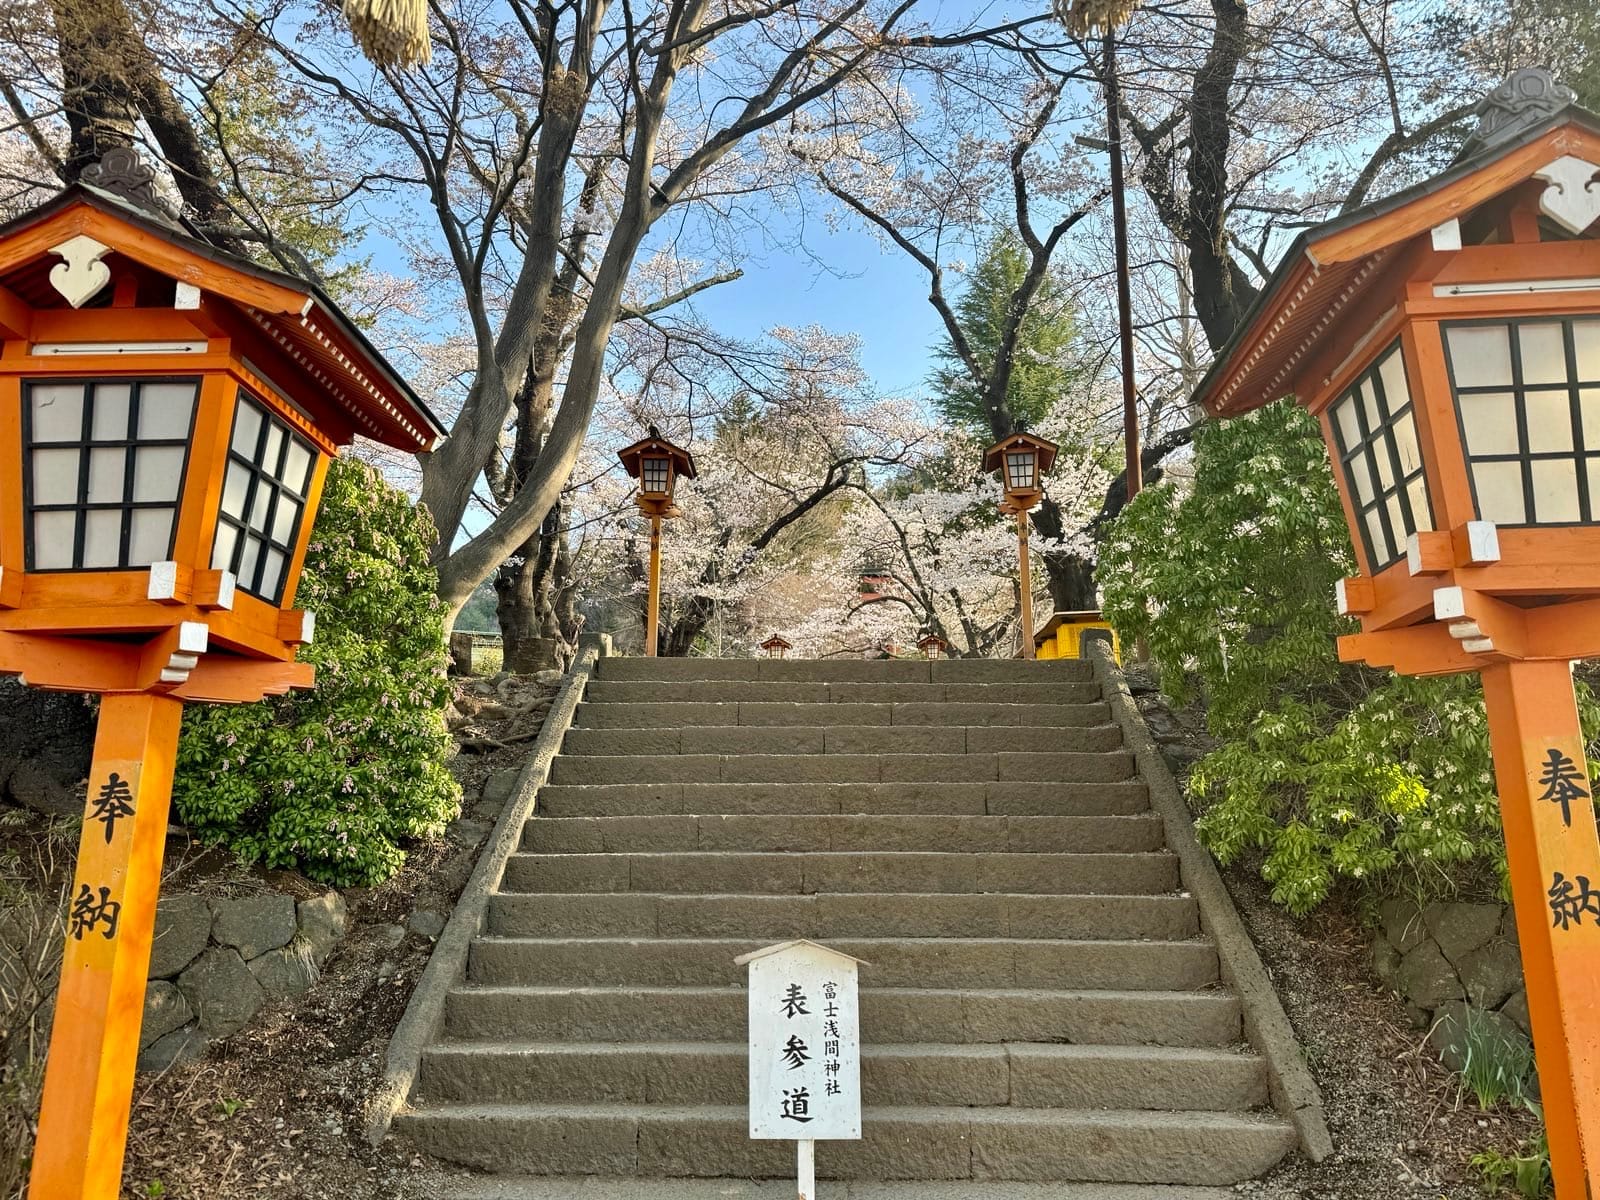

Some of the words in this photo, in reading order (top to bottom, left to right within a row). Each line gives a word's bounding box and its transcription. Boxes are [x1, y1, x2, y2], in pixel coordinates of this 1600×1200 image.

[68, 772, 136, 941] 奉納
[1537, 749, 1600, 931] 奉納
[778, 983, 814, 1123] 表参道
[822, 981, 842, 1097] 富士浅間神社
